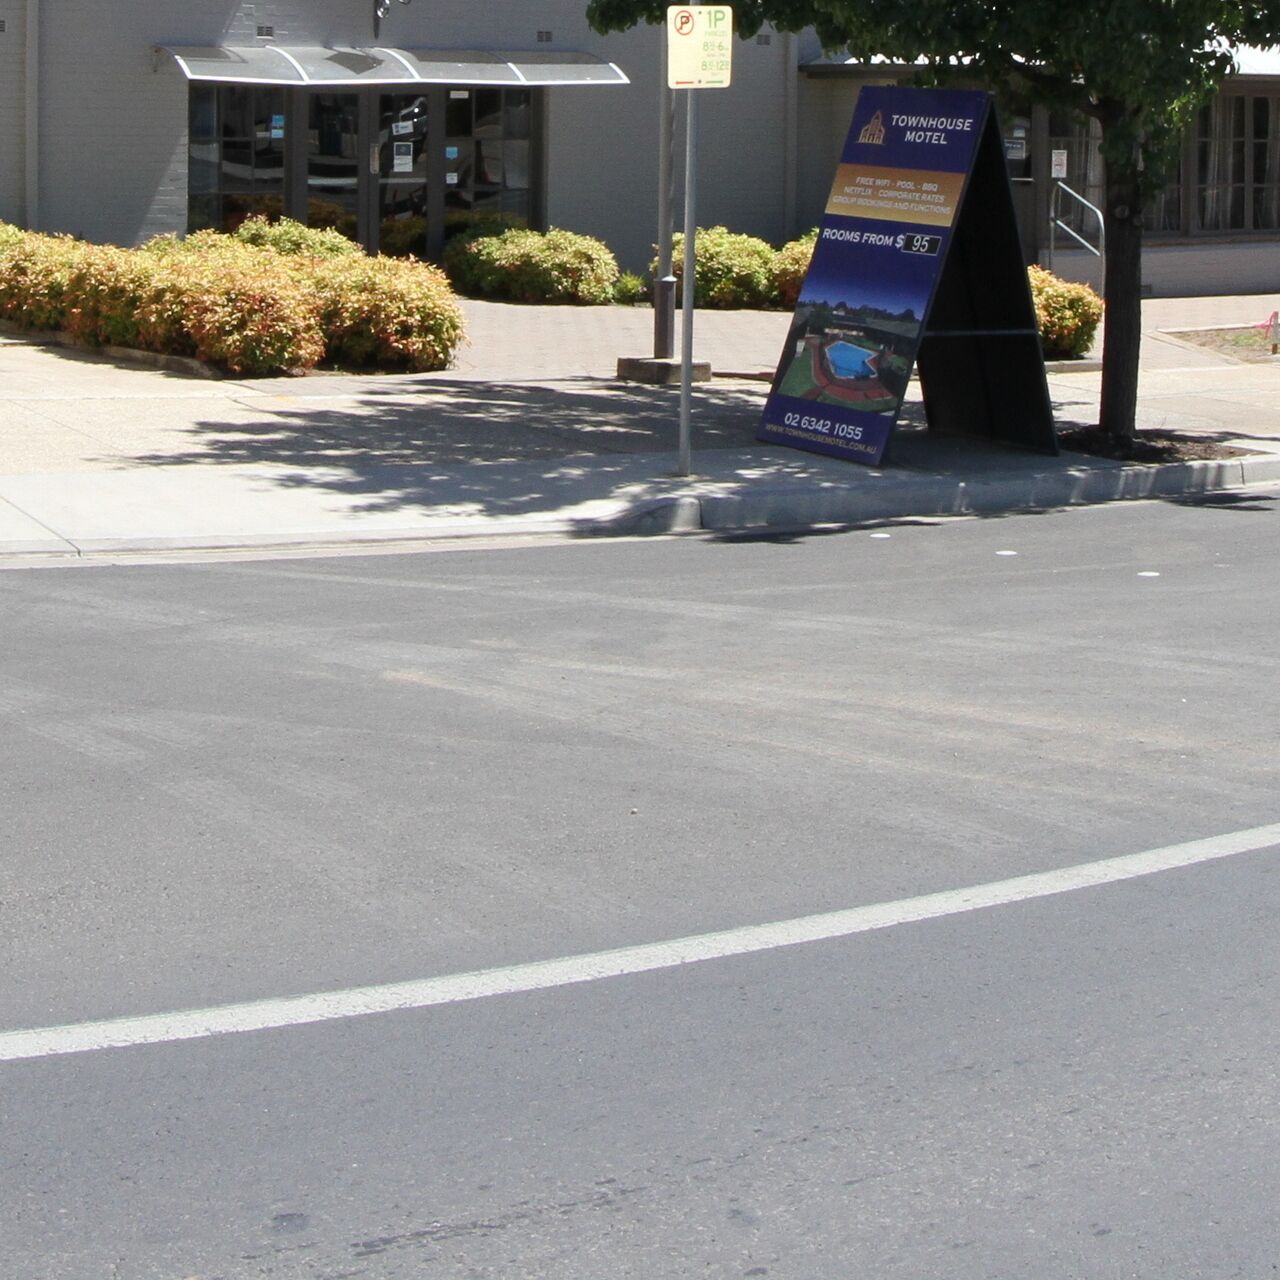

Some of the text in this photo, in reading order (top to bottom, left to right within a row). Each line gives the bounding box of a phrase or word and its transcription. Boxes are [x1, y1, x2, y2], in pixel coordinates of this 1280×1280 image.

[707, 10, 726, 29] 1P
[891, 114, 973, 131] TOWNHOUSE
[904, 130, 948, 145] MOTEL
[856, 176, 875, 186] FREE
[875, 177, 890, 187] WIFI
[896, 180, 915, 190] POOL
[878, 189, 921, 200] CORPORATE
[920, 193, 945, 203] RATES
[822, 227, 861, 243] ROOMS
[862, 232, 894, 246] FROM
[911, 236, 930, 252] 95
[784, 412, 863, 440] 02 6342 1055
